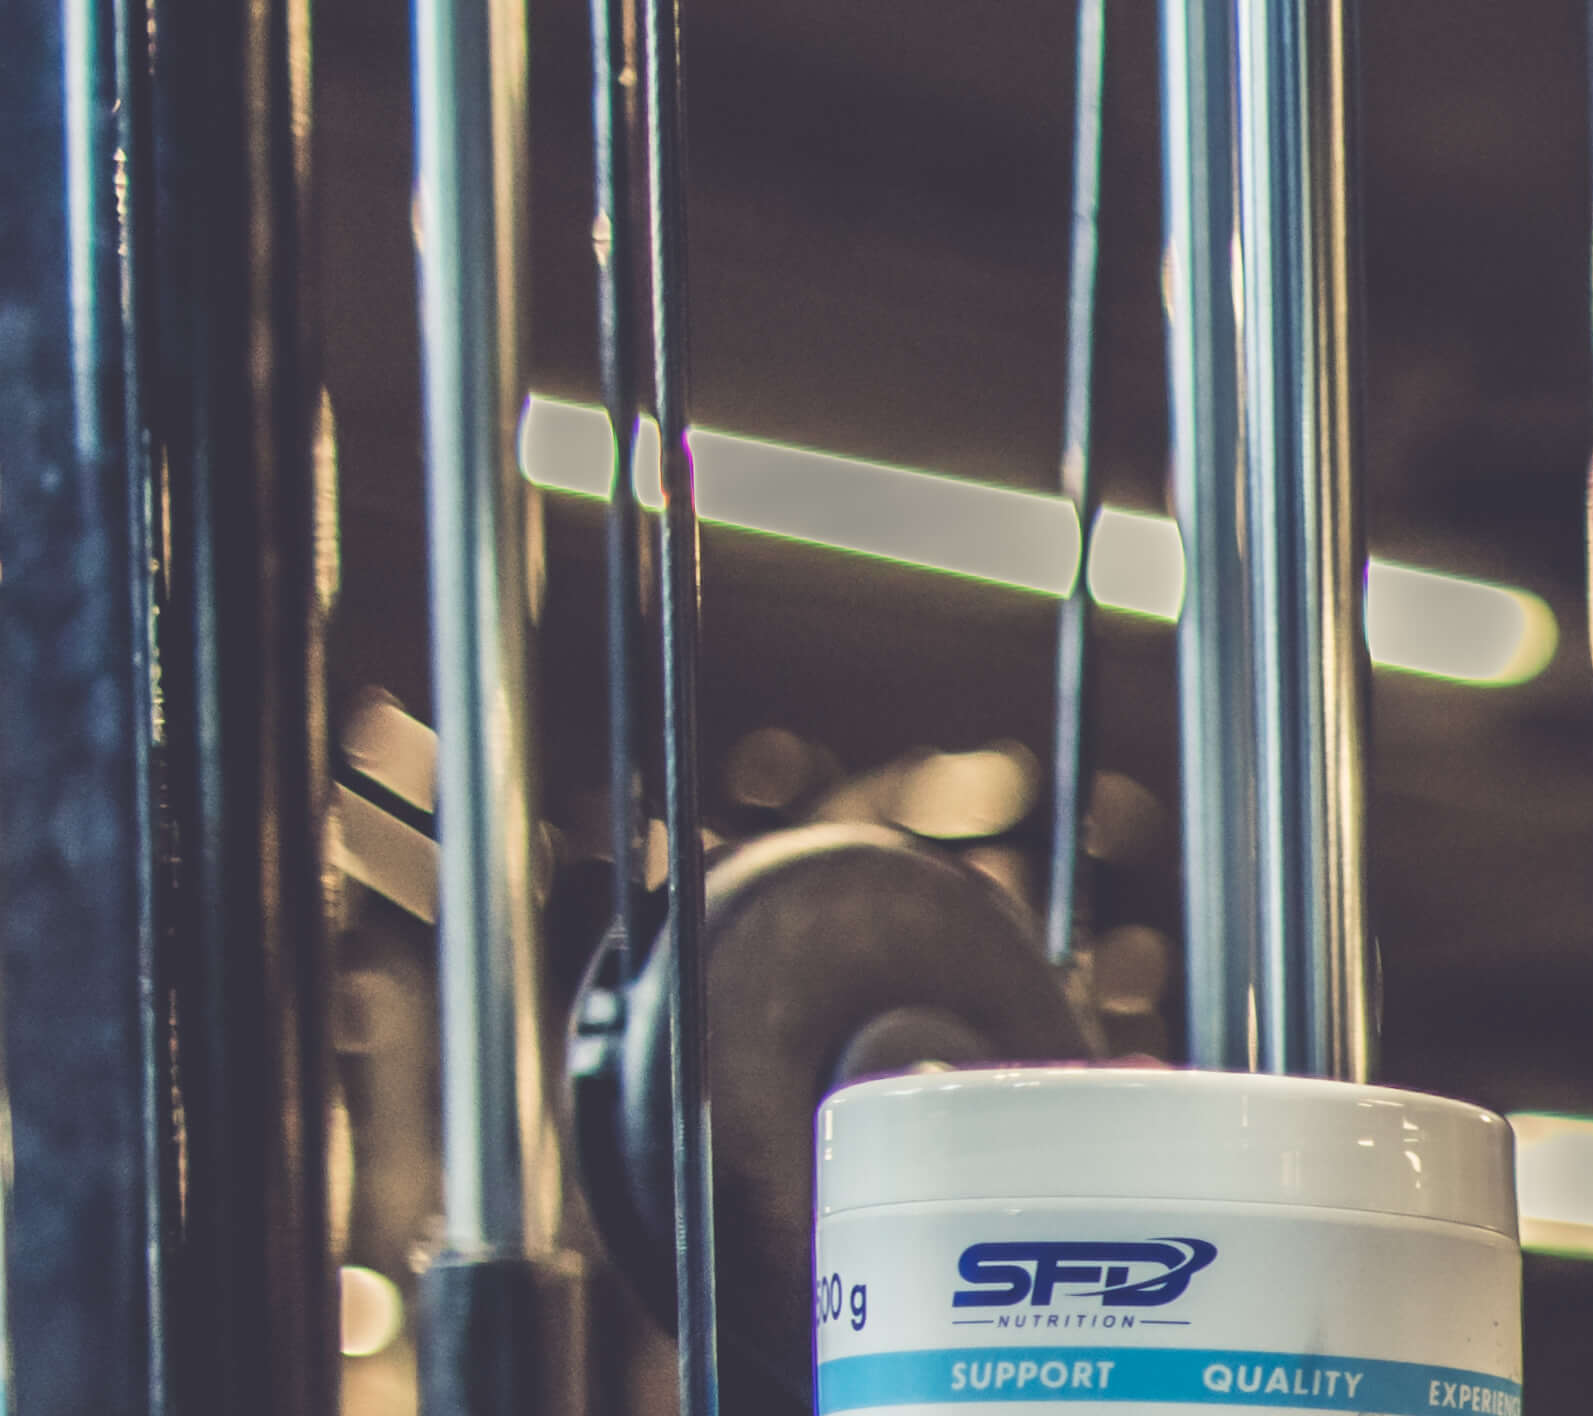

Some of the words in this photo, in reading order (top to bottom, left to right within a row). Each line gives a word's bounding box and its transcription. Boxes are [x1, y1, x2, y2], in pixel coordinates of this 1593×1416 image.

[952, 1237, 1218, 1307] SFD
[850, 1283, 867, 1332] g
[997, 1314, 1136, 1329] NUTRITION
[951, 1361, 1115, 1391] SUPPORT
[1203, 1363, 1363, 1399] QUALITY
